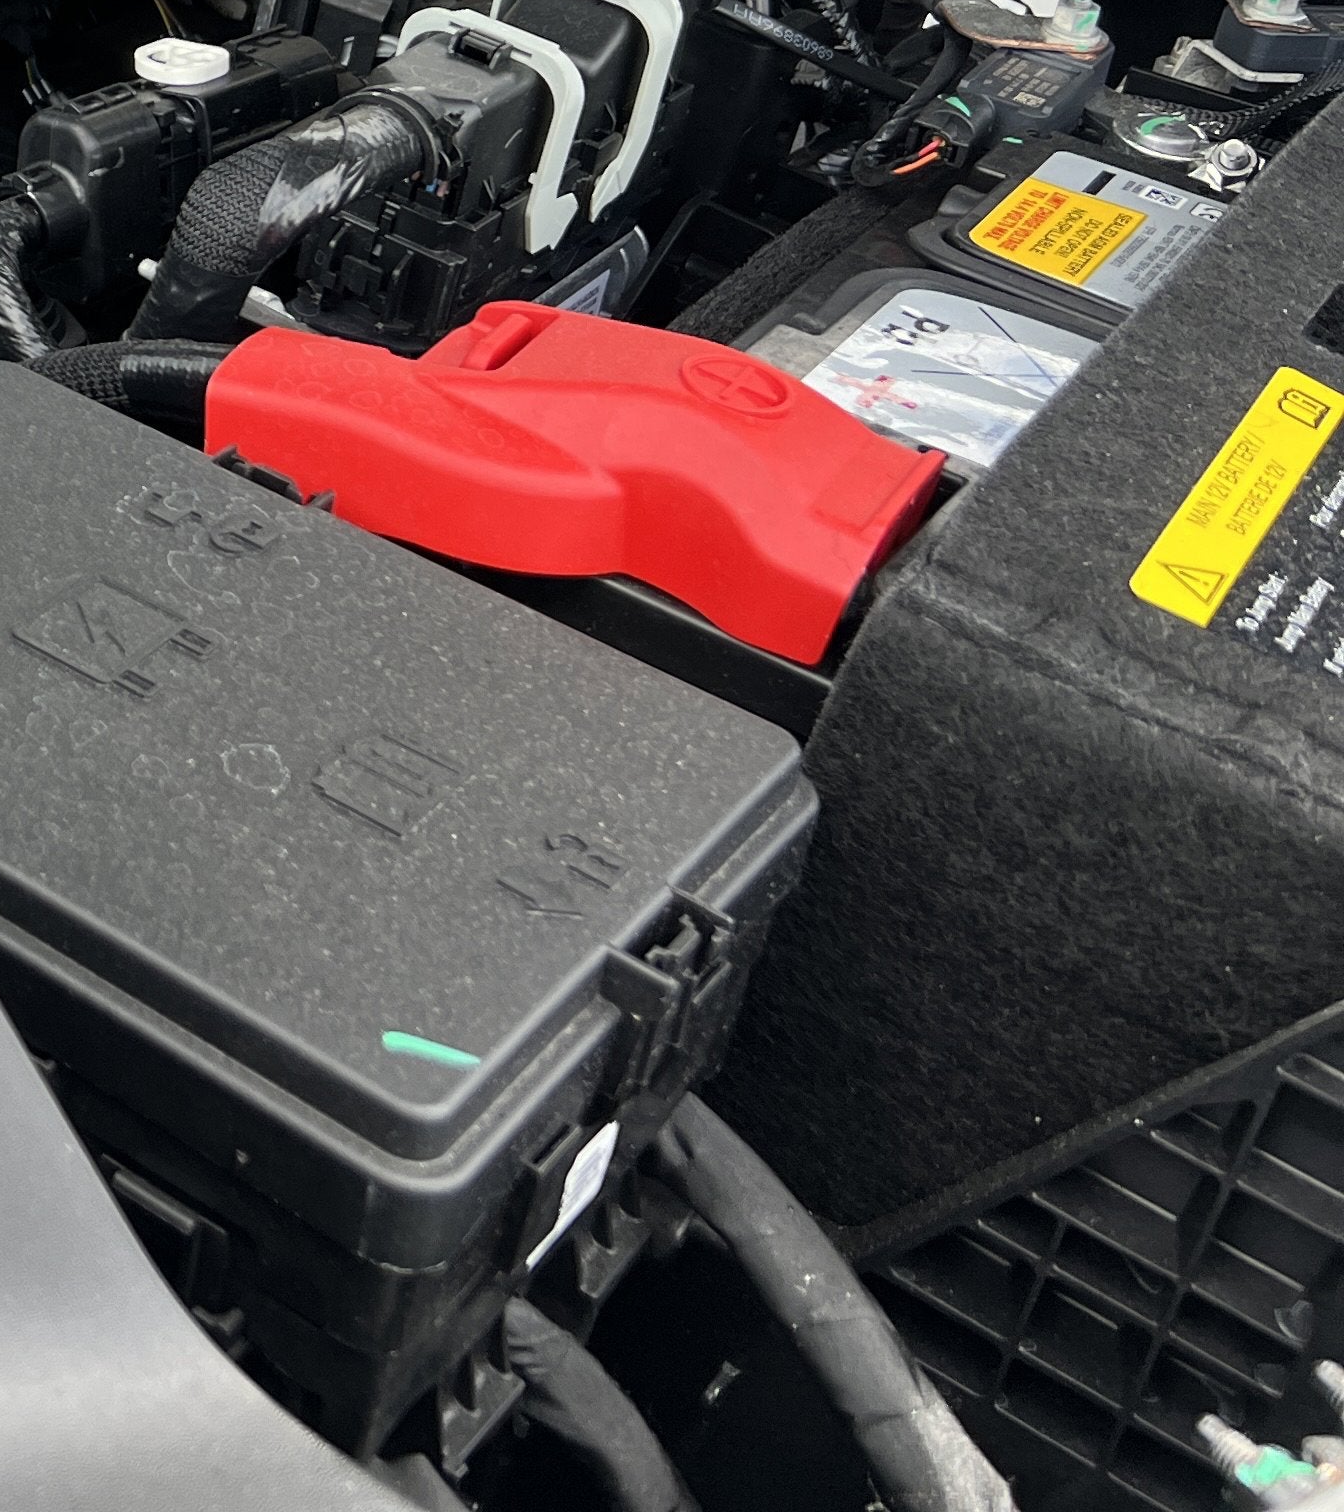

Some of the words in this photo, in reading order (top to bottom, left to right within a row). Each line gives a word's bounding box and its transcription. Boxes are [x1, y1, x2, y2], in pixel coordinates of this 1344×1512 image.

[1215, 434, 1260, 486] BATTERY
[1185, 494, 1221, 530] MAIN
[1205, 478, 1233, 505] 12V
[1224, 485, 1270, 537] BATTERIE
[1255, 475, 1277, 498] DE
[1267, 457, 1289, 482] 12V
